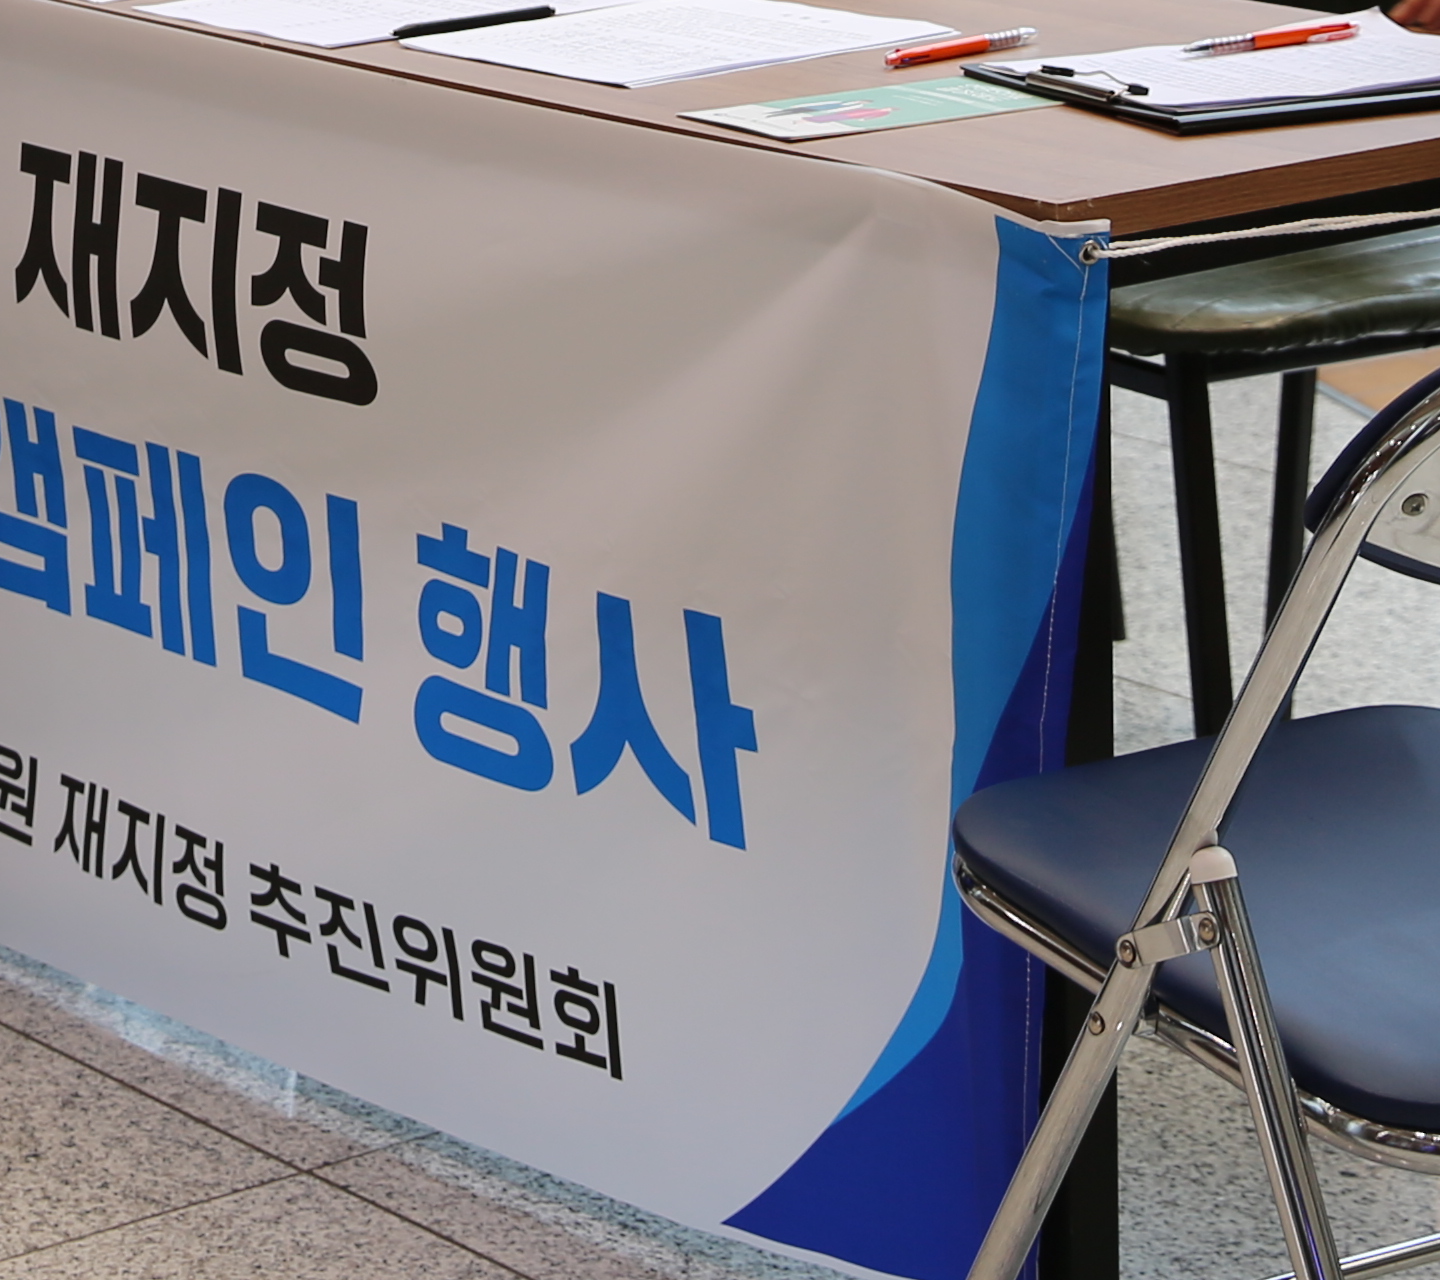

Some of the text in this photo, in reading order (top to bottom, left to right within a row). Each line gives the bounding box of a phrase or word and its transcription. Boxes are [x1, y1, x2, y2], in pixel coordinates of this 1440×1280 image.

[15, 142, 378, 406] 재지정
[414, 521, 758, 851] 행사
[54, 772, 228, 932] 재지정
[248, 862, 623, 1081] 추진위원회
